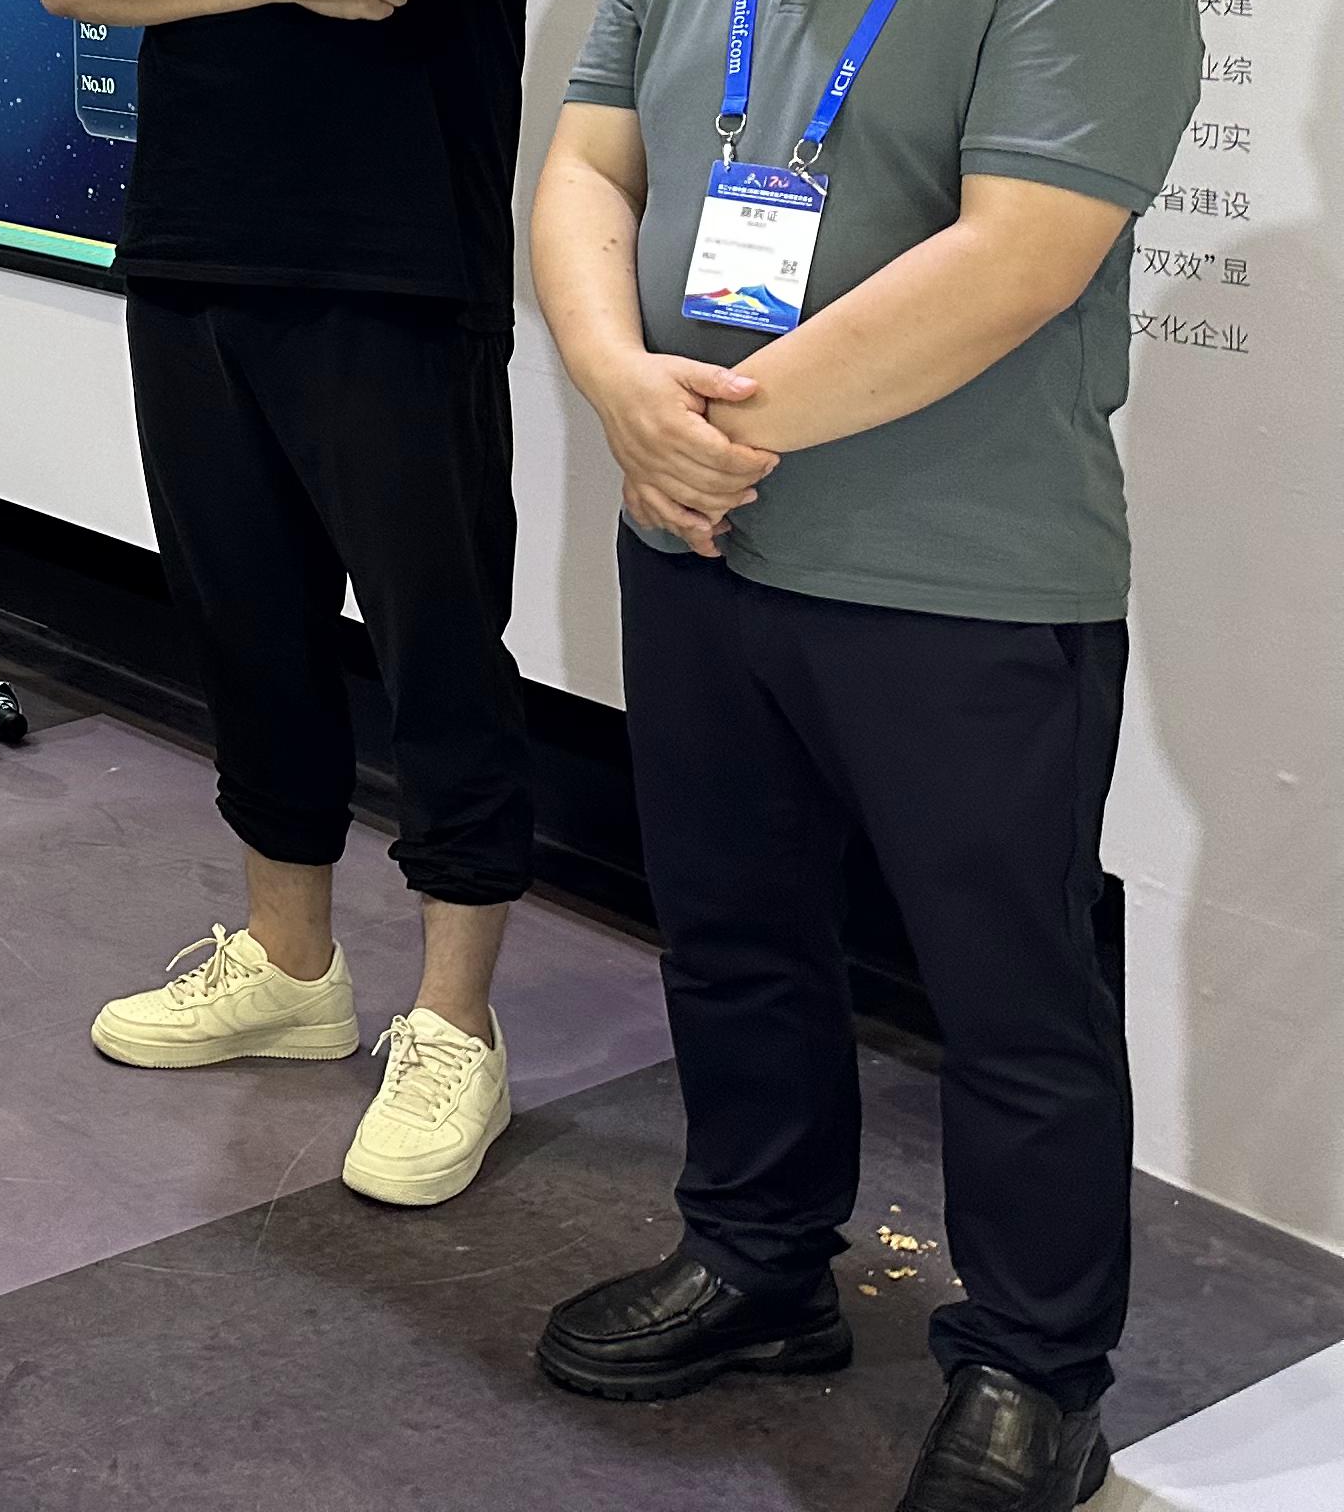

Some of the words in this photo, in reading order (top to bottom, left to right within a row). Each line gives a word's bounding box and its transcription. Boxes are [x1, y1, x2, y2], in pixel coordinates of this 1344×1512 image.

[79, 22, 107, 41] No.9
[81, 74, 115, 95] No.10
[830, 59, 857, 97] ICIF
[1189, 120, 1251, 154] 切实
[1152, 184, 1251, 222] 省建设
[1130, 310, 1250, 355] 文化企业
